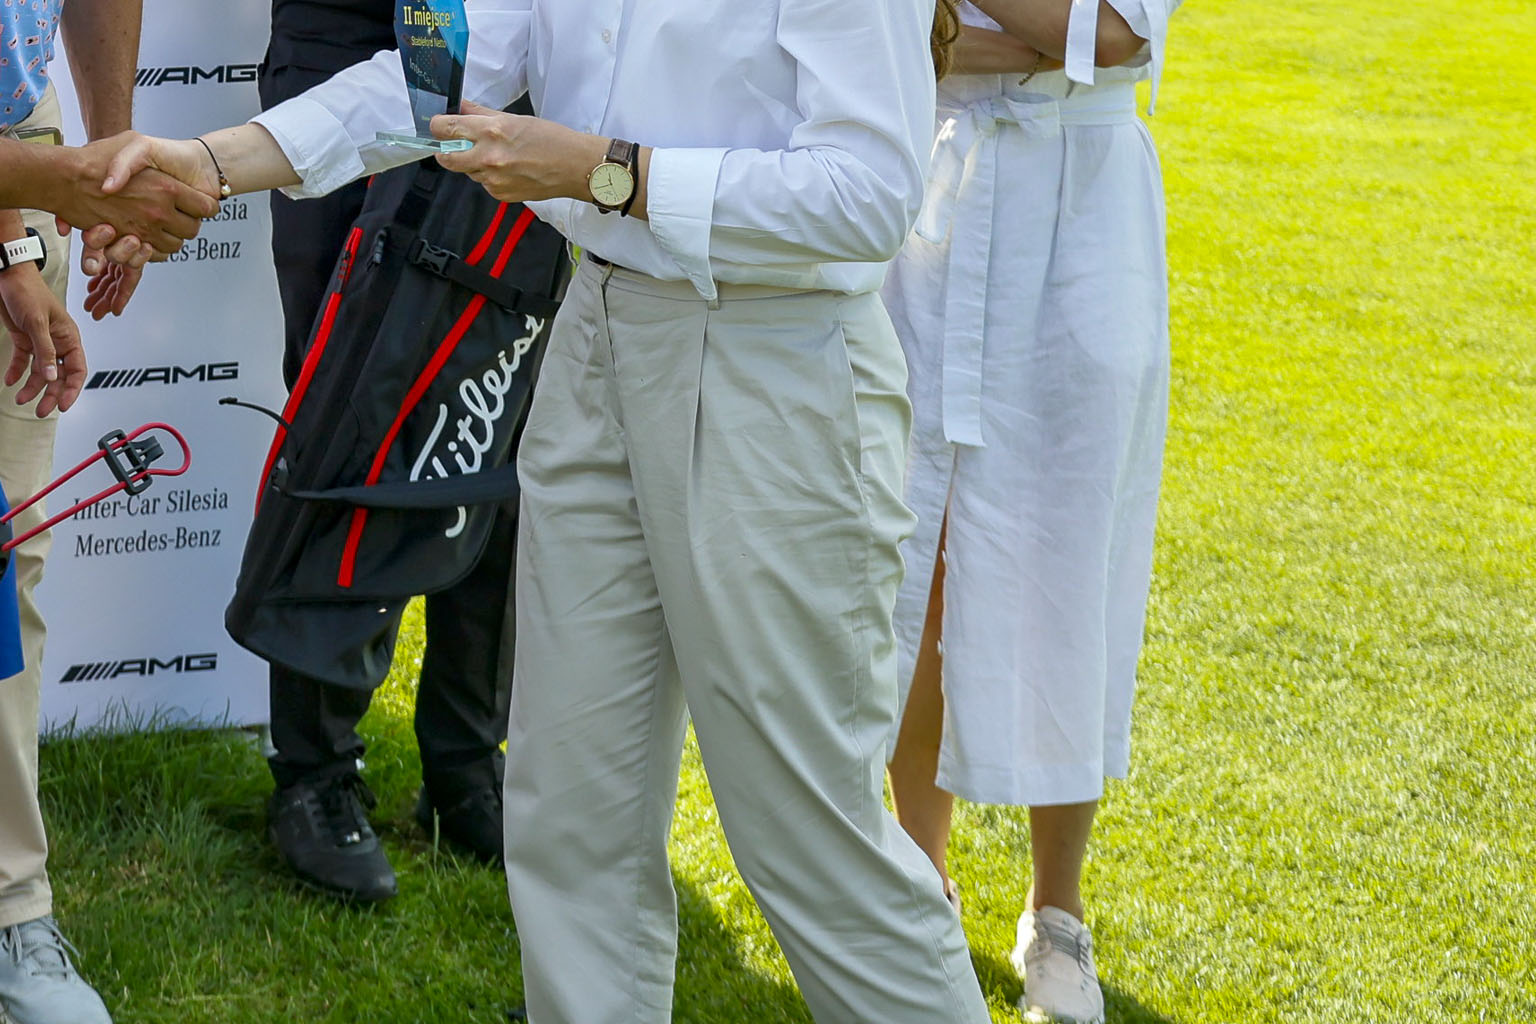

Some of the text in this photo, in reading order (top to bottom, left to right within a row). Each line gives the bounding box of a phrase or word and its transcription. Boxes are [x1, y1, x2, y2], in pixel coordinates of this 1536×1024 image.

[403, 5, 451, 31] II miejsce
[155, 63, 259, 86] AMG
[139, 362, 238, 385] AMG
[167, 488, 227, 512] Silesia
[75, 527, 221, 557] Mercedes-Benz
[114, 652, 217, 676] AMG
